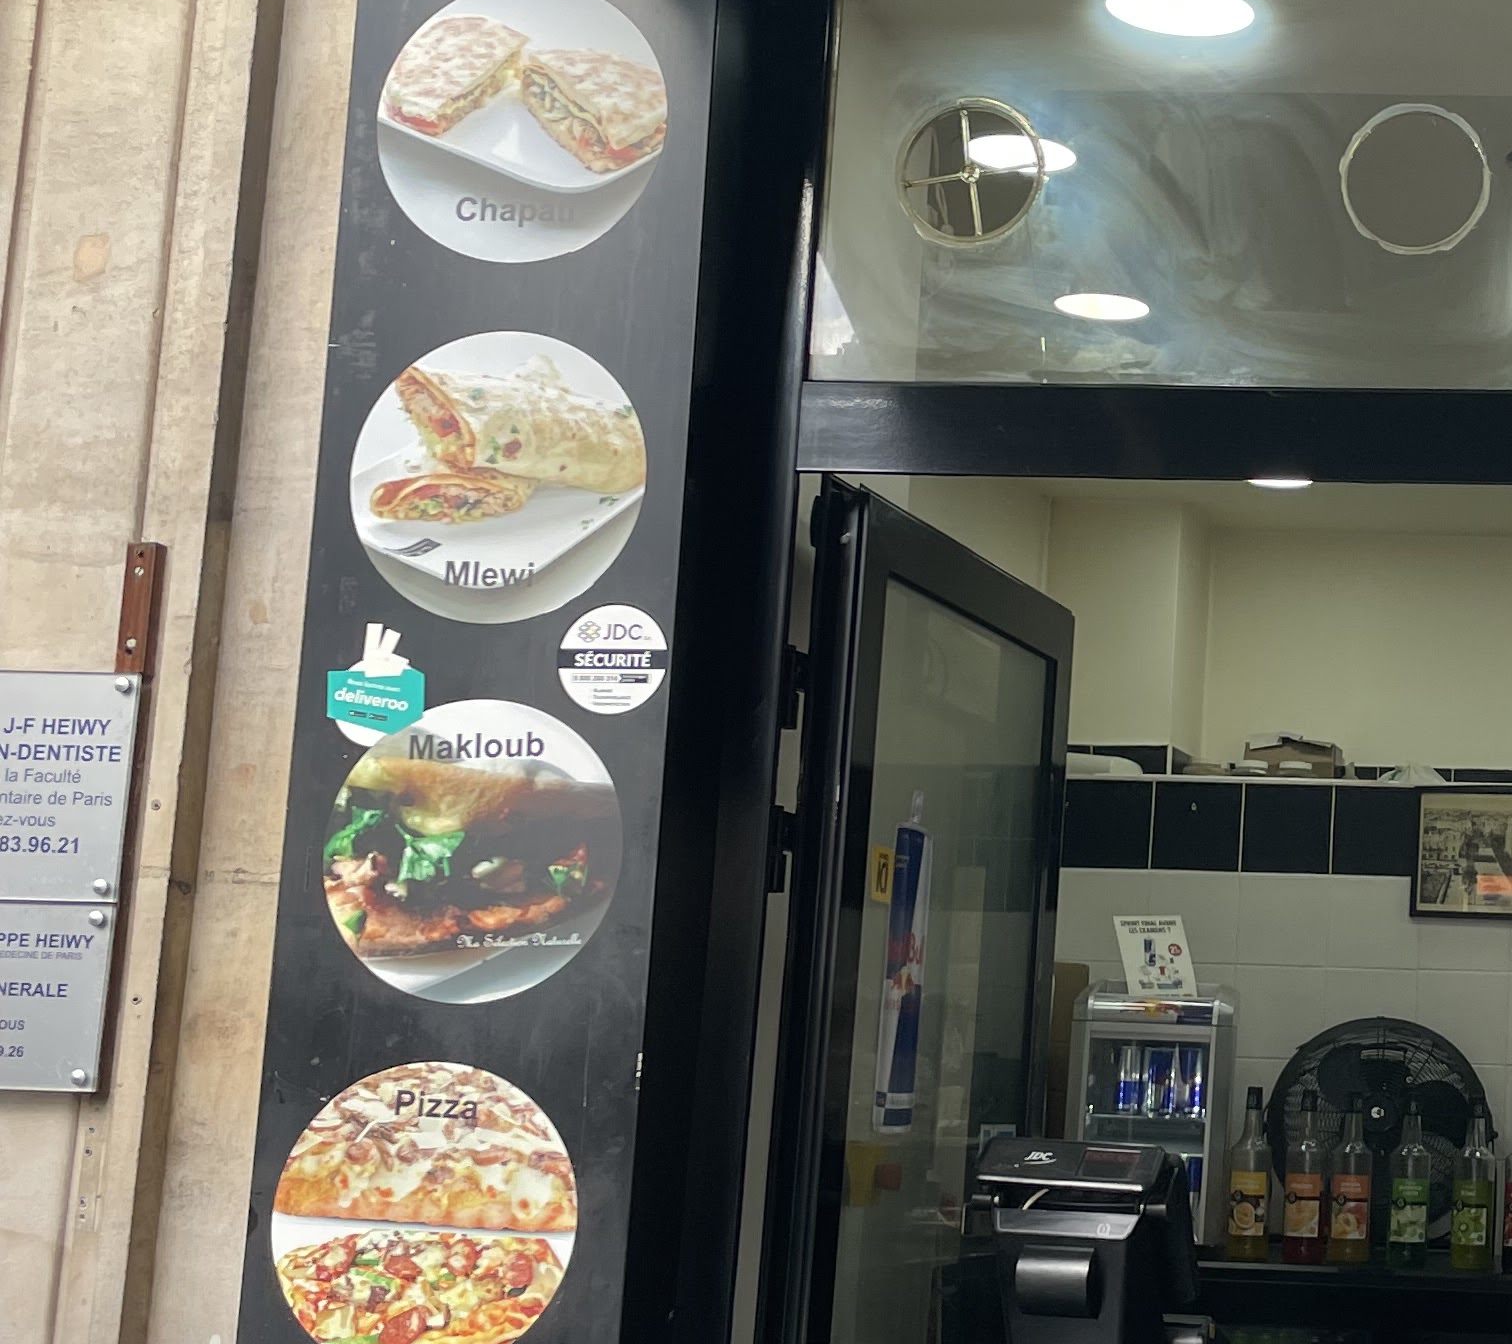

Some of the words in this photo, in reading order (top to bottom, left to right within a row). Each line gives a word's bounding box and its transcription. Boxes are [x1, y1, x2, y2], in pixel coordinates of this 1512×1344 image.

[444, 560, 534, 588] Mlewi
[603, 623, 644, 641] JDC
[574, 650, 652, 668] SÉCURITÉ
[333, 687, 409, 712] deliveroo
[3, 717, 37, 735] J-F
[41, 717, 113, 737] HEIWY
[0, 743, 122, 763] N-DENTISTE
[409, 732, 545, 761] Makloub
[4, 767, 18, 782] la
[23, 767, 82, 784] Faculté
[0, 790, 43, 805] ntaire
[47, 790, 67, 806] de
[71, 790, 113, 807] Paris
[0, 834, 80, 855] 83.96.21
[35, 933, 95, 949] HEIWY
[395, 1089, 479, 1121] Pizza
